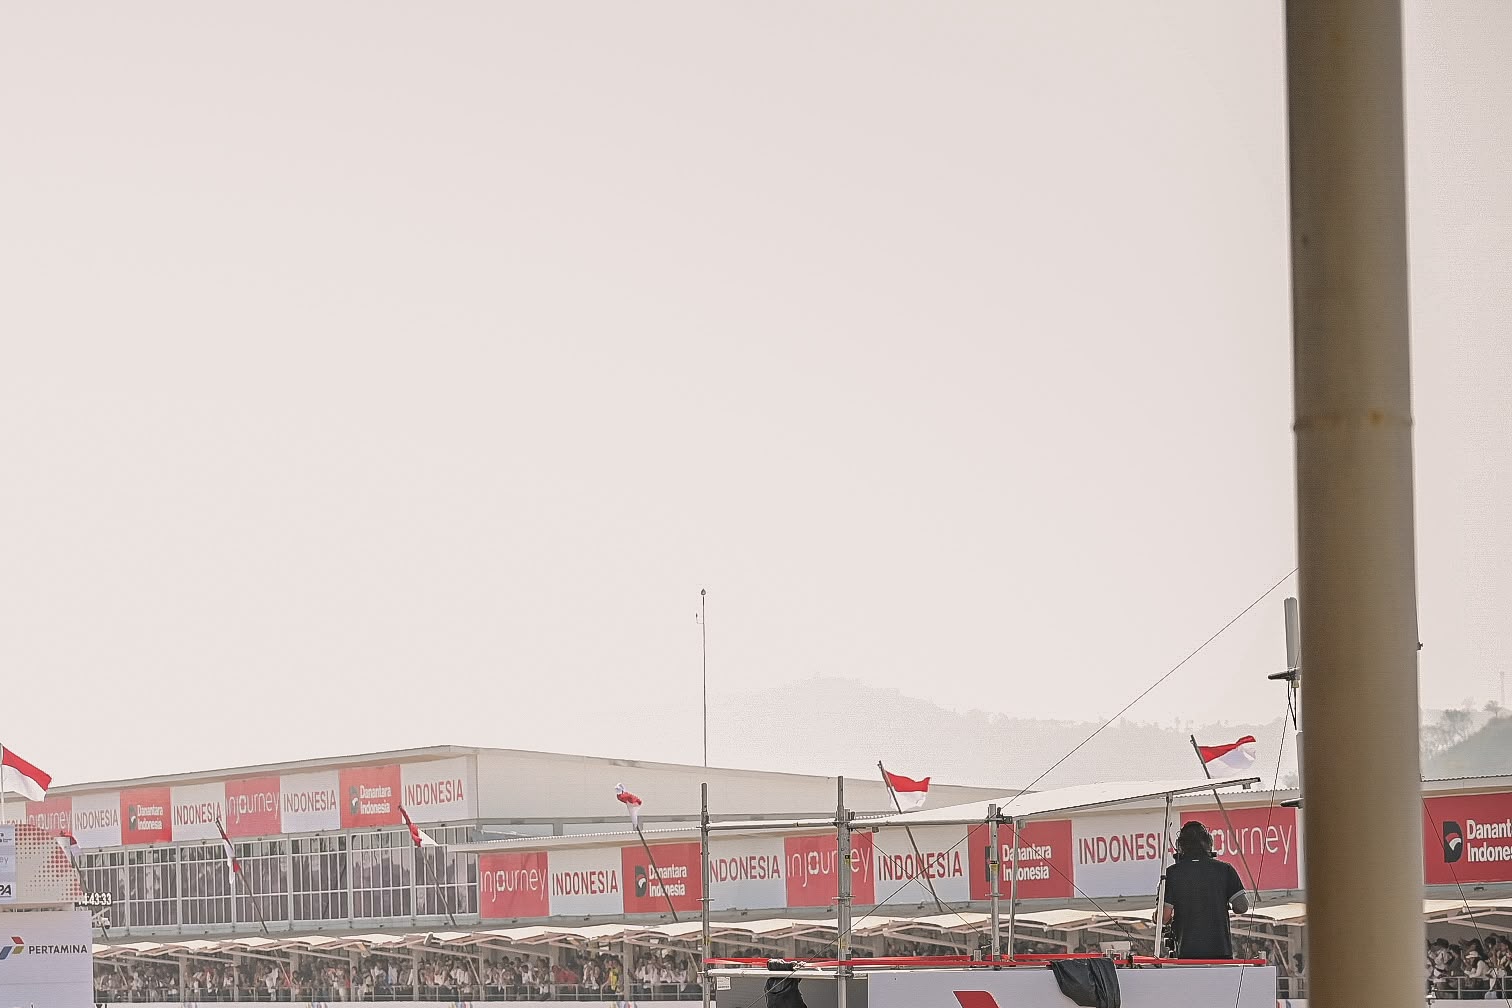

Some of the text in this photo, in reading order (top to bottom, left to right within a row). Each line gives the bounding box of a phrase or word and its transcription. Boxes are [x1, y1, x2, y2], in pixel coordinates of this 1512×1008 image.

[283, 789, 337, 813] INDONESIA
[359, 784, 392, 799] Danantara
[404, 779, 464, 806] INDONESIA
[137, 804, 164, 816] Danantara
[173, 802, 222, 825] INDONESIA
[359, 800, 391, 814] Indonesia
[74, 809, 119, 831] INDONESIA
[137, 818, 163, 830] Indonesia
[1078, 833, 1175, 864] INDONESI
[1212, 824, 1292, 864] ourney
[1466, 841, 1512, 862] Indone
[709, 855, 781, 883] NDONESIA
[787, 847, 870, 888] injourey
[877, 850, 963, 881] INDONESIA
[480, 868, 546, 903] injourney
[552, 869, 619, 896] INDONESIA
[28, 944, 88, 954] PERTAMINA
